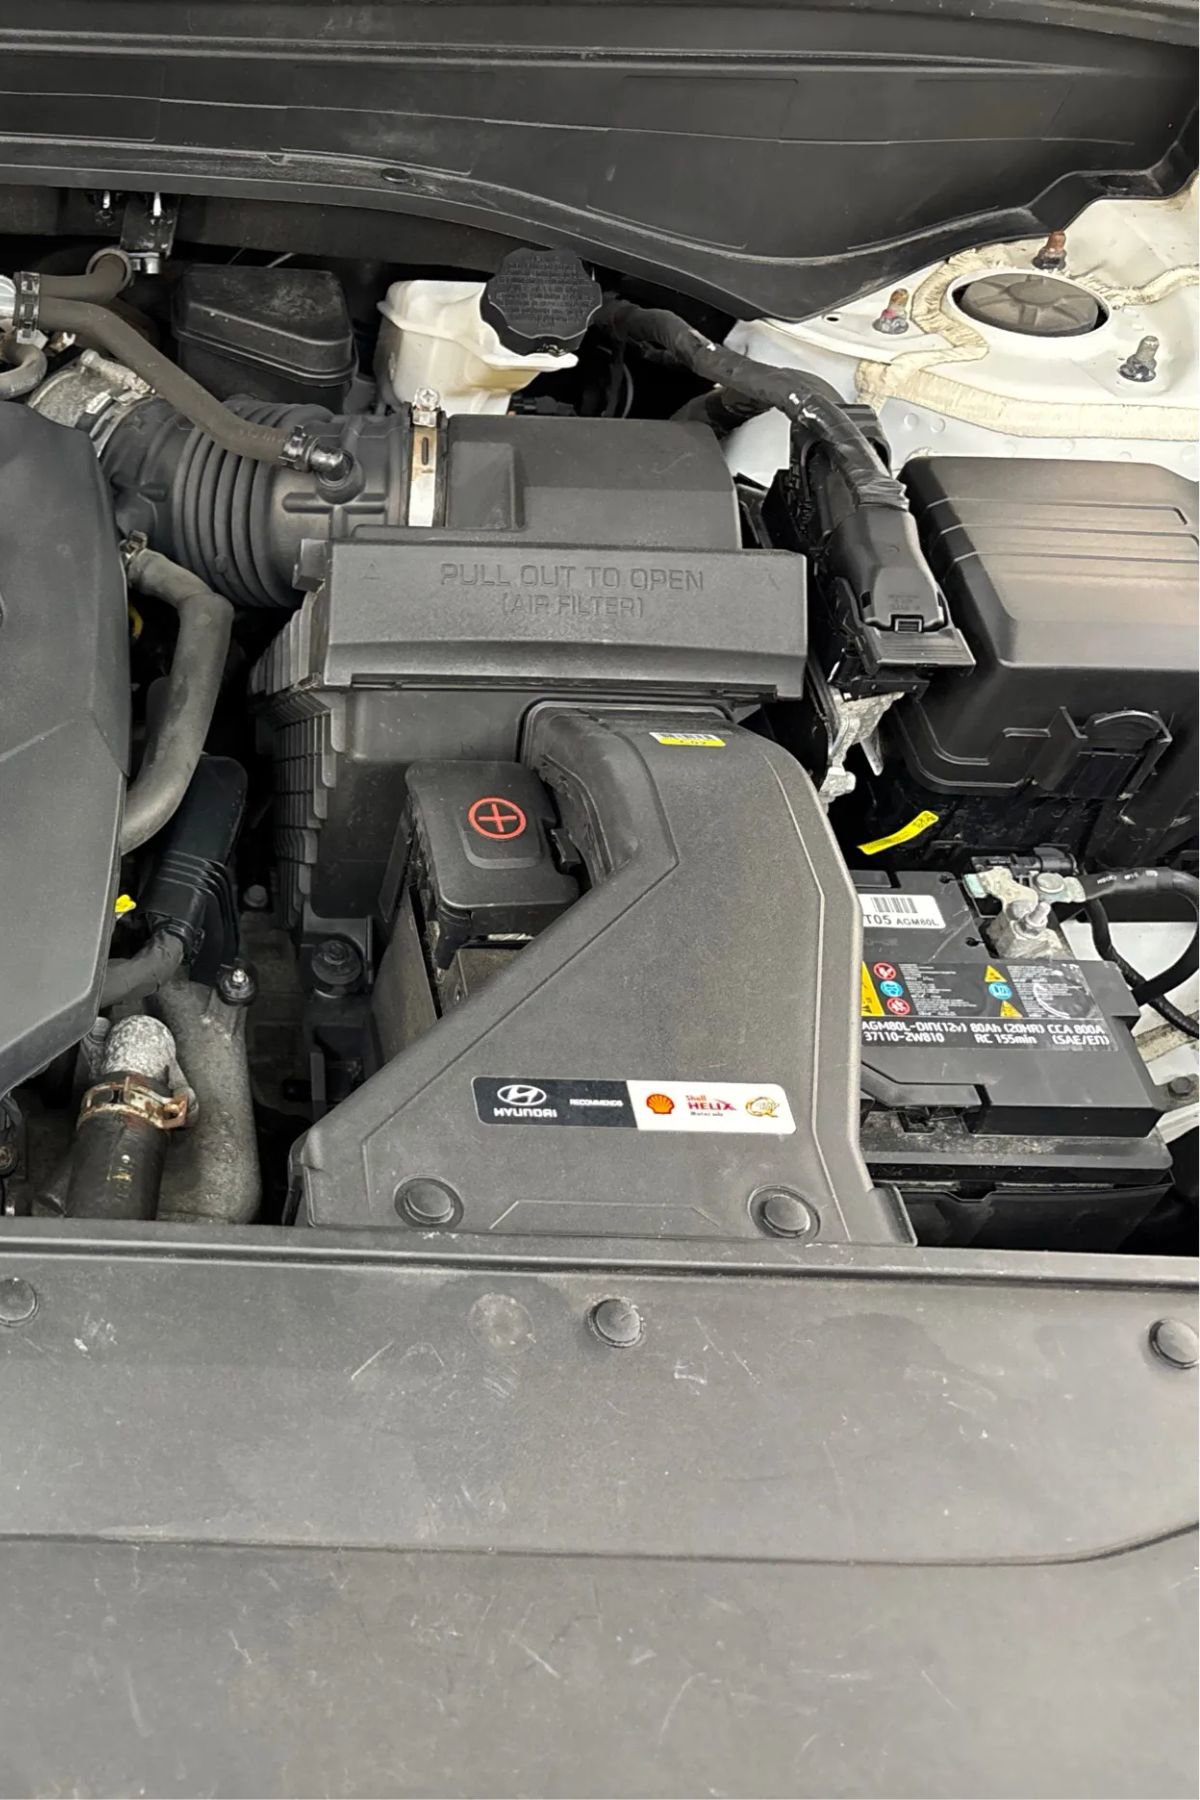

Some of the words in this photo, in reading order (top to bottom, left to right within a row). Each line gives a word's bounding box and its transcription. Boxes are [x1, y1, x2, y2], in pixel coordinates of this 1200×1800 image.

[440, 563, 510, 586] PULL
[519, 564, 576, 588] OUT
[584, 565, 621, 589] TO
[629, 567, 705, 591] OPEN
[501, 593, 550, 617] (AIR
[557, 594, 644, 619] FILTER)
[896, 918, 940, 927] AGM80L
[969, 1023, 1002, 1033] 80Ah
[1003, 1023, 1045, 1034] (20HR)
[1046, 1024, 1074, 1034] CCA
[1073, 1024, 1106, 1035] 800A
[864, 1031, 945, 1043] 37110-2W810
[974, 1033, 993, 1044] RC
[994, 1034, 1038, 1045] 155min
[688, 1099, 736, 1111] HELIX
[493, 1107, 558, 1118] HYUNDAI
